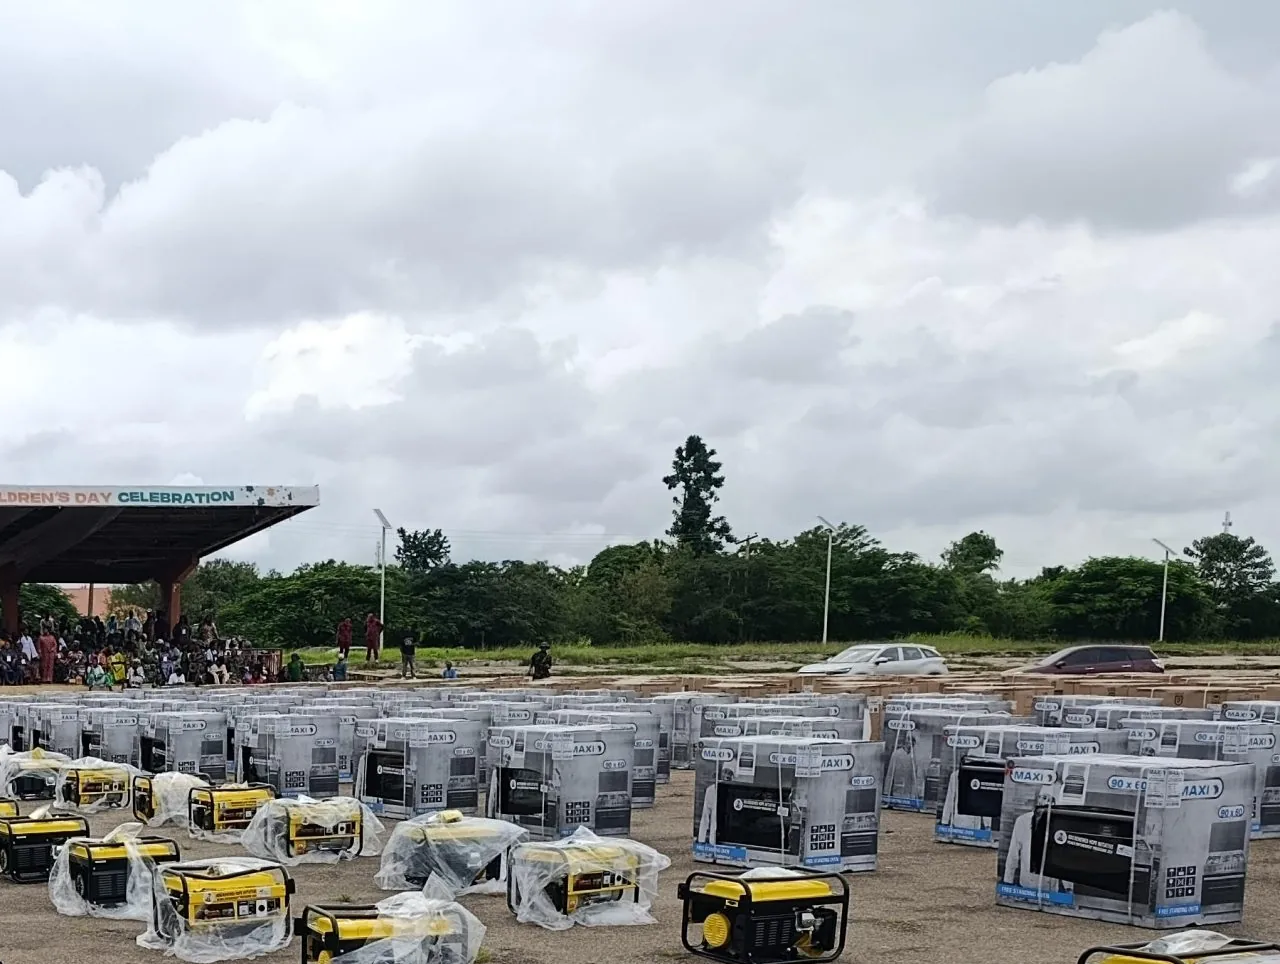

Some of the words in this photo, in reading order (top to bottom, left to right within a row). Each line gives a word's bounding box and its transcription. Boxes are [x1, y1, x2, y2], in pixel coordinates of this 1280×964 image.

[75, 492, 113, 504] DAY
[117, 490, 235, 504] CELEBRATION
[1013, 770, 1044, 782] MAXI
[1111, 779, 1124, 788] 90
